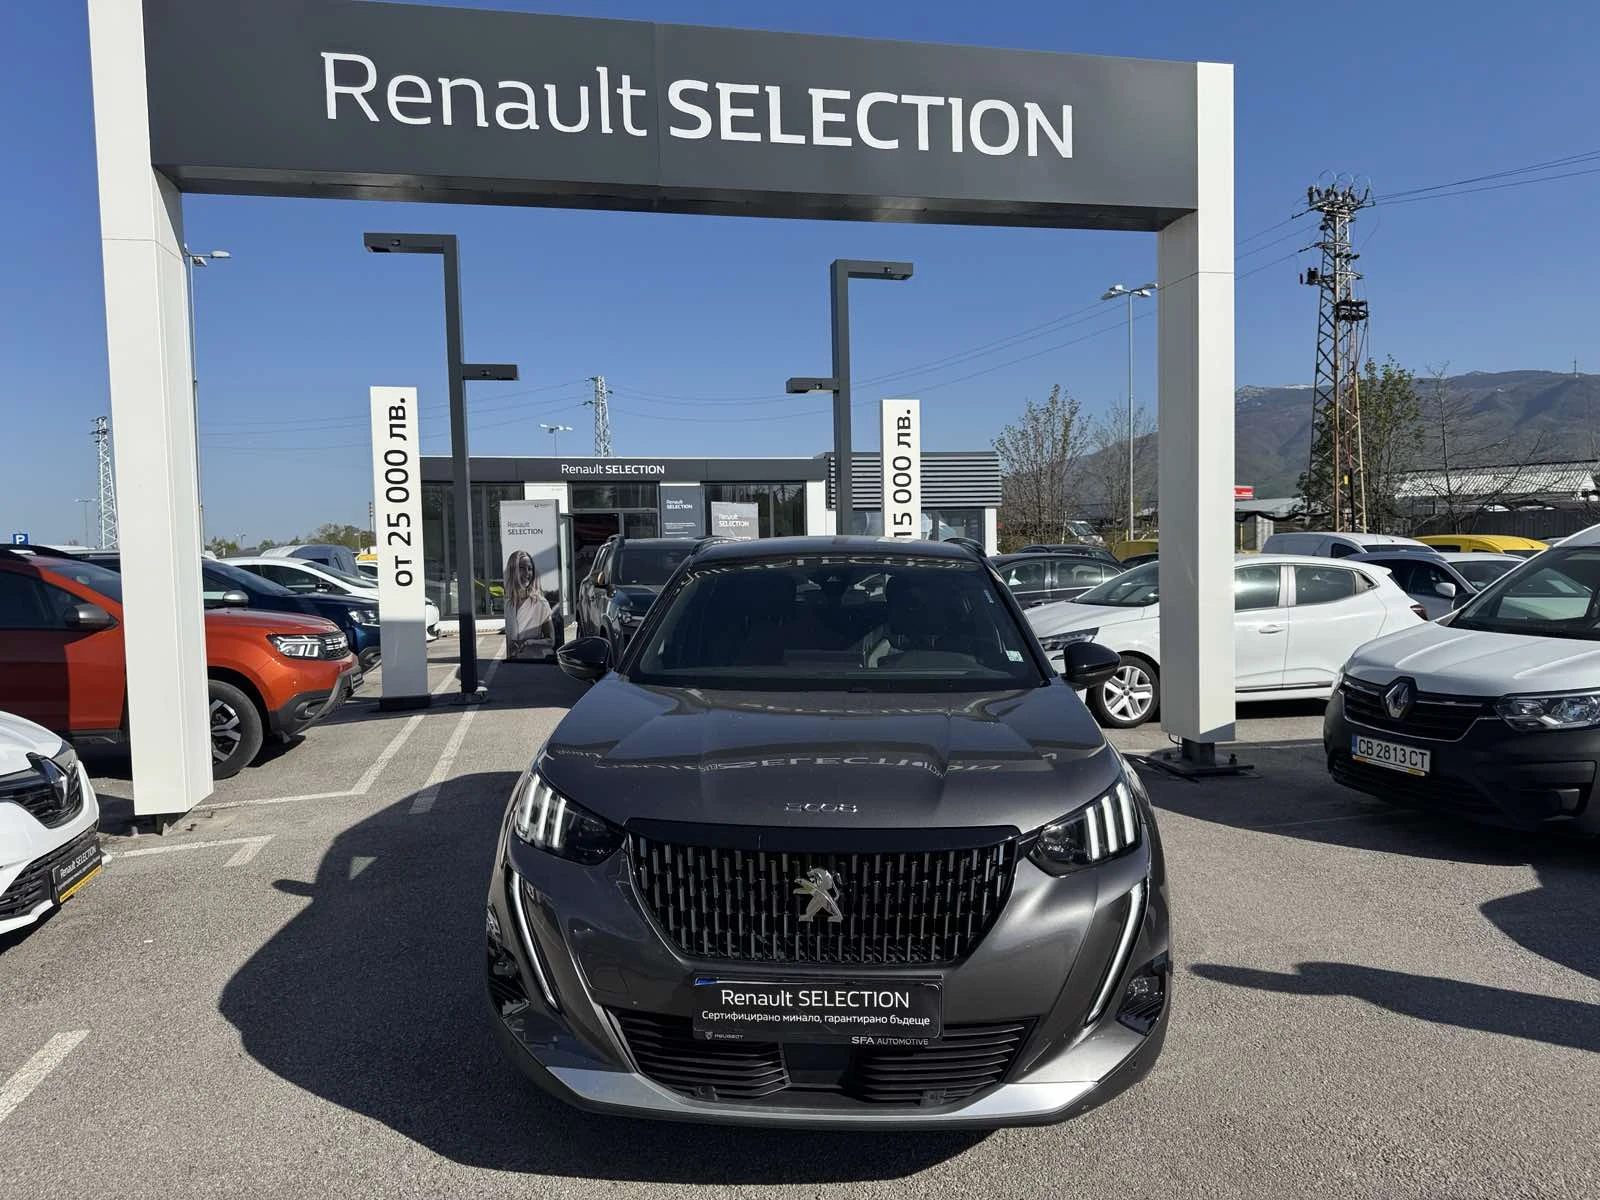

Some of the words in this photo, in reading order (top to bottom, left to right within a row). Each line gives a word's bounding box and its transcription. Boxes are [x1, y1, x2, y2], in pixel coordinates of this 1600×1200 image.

[320, 52, 648, 137] Renault
[667, 79, 1074, 159] SELECTION
[383, 449, 410, 503] 000
[561, 463, 604, 474] Renault
[605, 465, 665, 474] SELECTION
[892, 455, 912, 504] 000
[387, 512, 412, 547] 25
[893, 512, 912, 538] 15
[1376, 743, 1407, 763] 2813
[721, 990, 794, 1006] Renault
[798, 991, 910, 1008] SELECTION
[702, 1010, 781, 1023] Сертифицирано
[782, 1013, 823, 1024] минало,
[824, 1015, 888, 1026] гарантирано
[889, 1015, 931, 1026] бъдеще
[851, 1036, 874, 1045] SFA
[877, 1037, 929, 1046] AUTOMOTIVE
